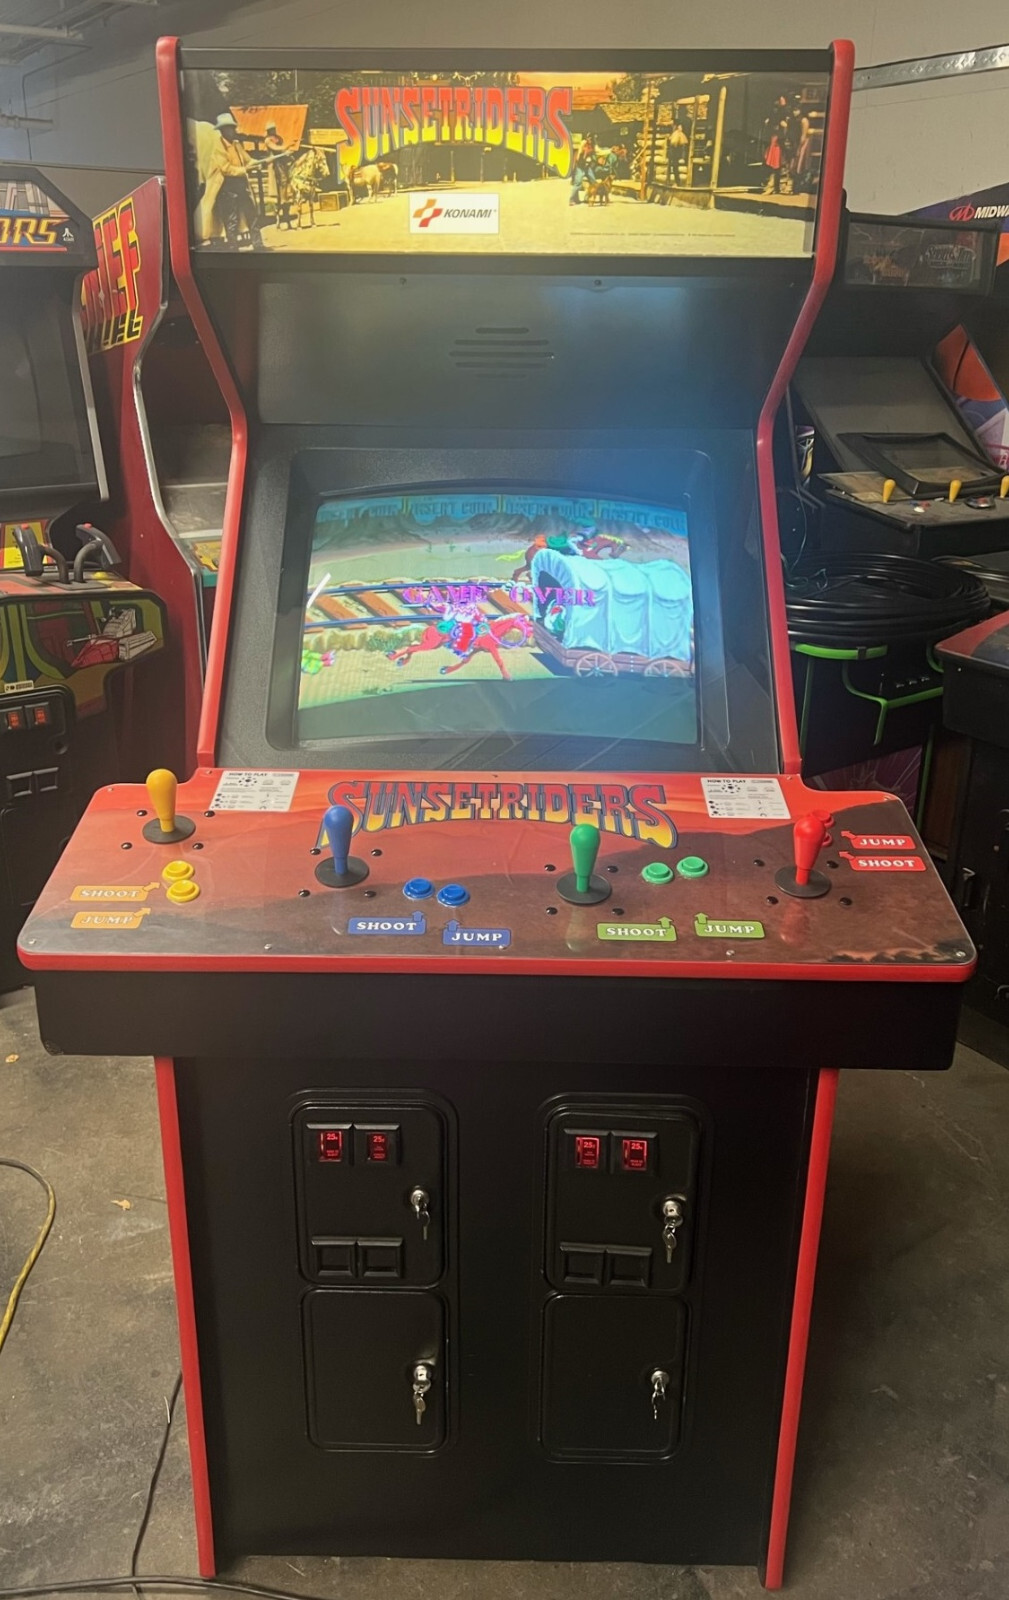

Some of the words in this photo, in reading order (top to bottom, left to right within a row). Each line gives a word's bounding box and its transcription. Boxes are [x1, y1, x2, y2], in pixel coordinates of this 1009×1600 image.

[443, 208, 493, 219] KONAMI
[411, 502, 455, 515] INSERT
[461, 502, 493, 515] COIN
[402, 585, 489, 604] GAME
[509, 586, 596, 606] OVER
[859, 837, 906, 847] JUMP
[857, 858, 916, 868] SHOOT
[80, 888, 141, 899] SHOOT
[80, 915, 134, 925] JUMP
[356, 921, 417, 931] SHOOT
[704, 924, 755, 934] JUMP
[451, 932, 503, 942] JUMP
[606, 927, 667, 937] SHOOT
